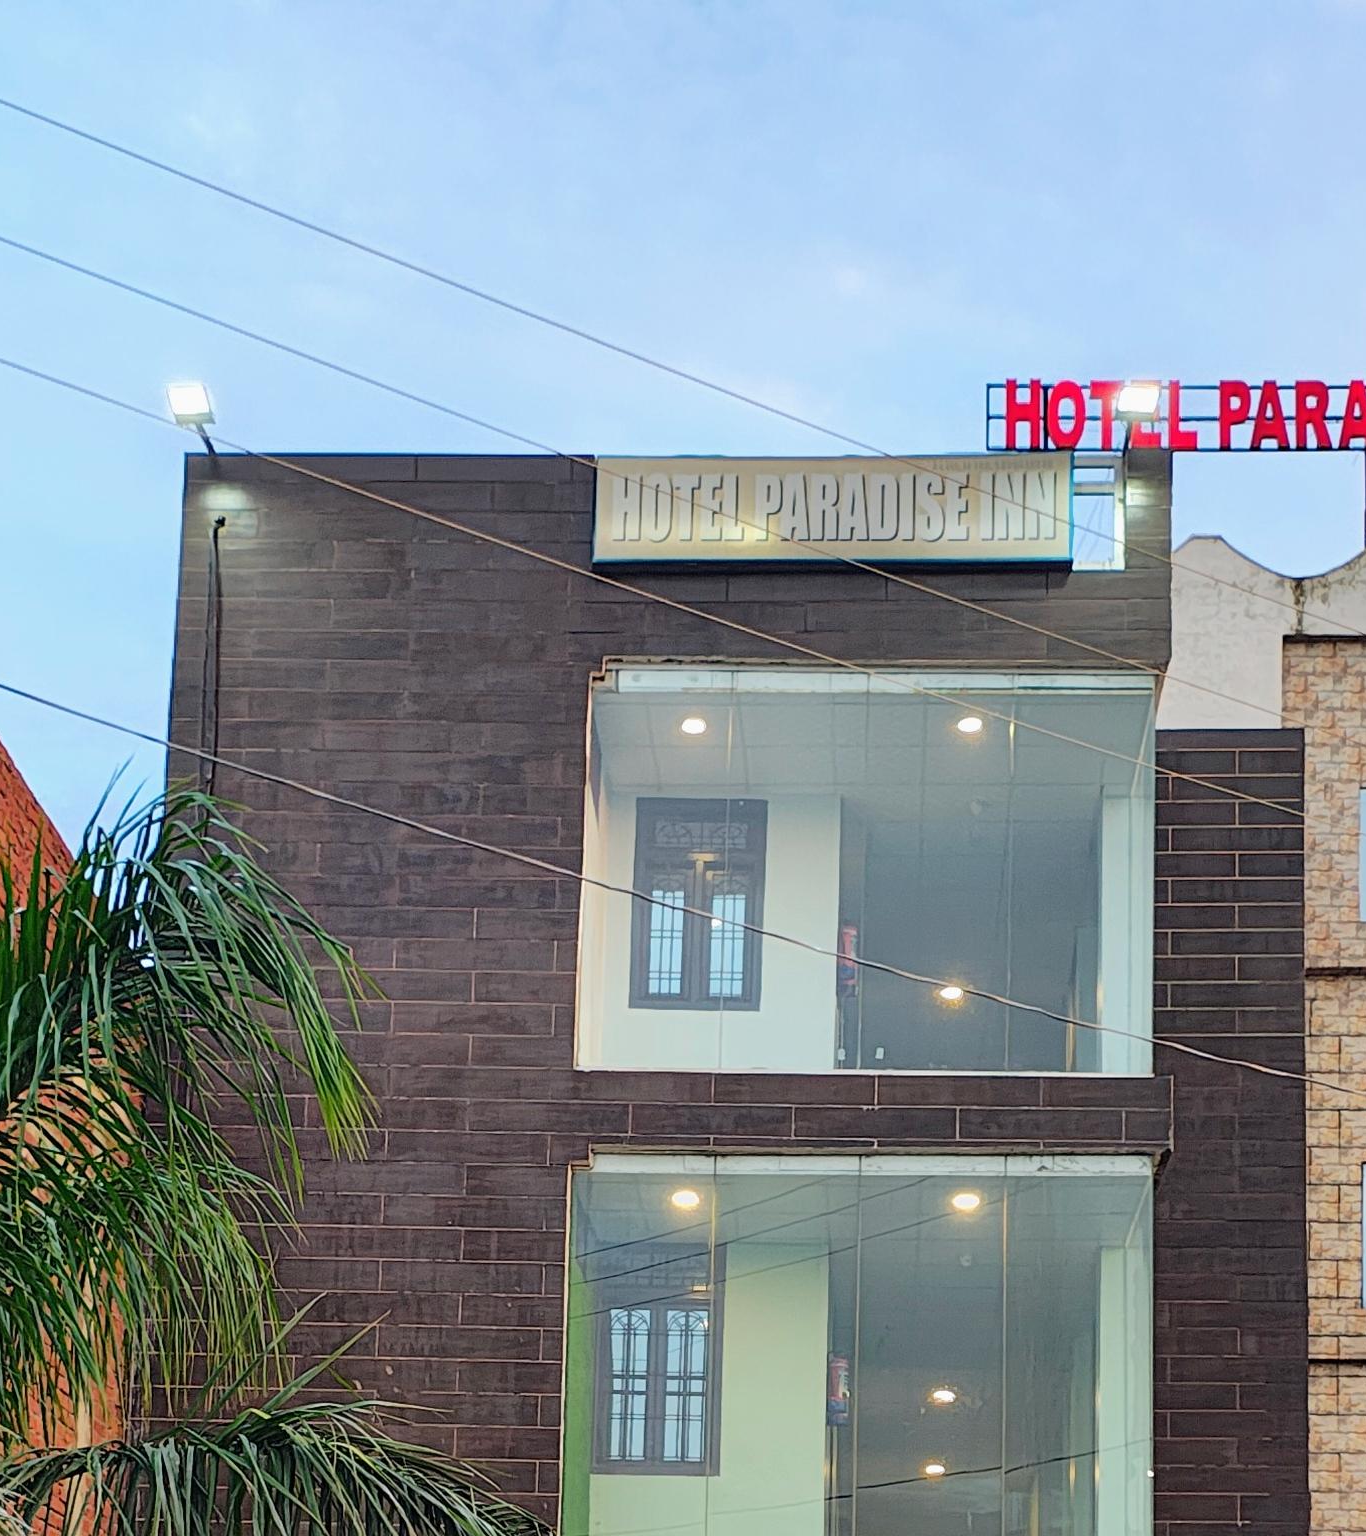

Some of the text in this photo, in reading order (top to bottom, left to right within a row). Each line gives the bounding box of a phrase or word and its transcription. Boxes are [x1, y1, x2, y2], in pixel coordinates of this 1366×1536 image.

[1005, 379, 1197, 451] HOTEL
[612, 471, 1058, 543] HOTEL PARADISE INN
